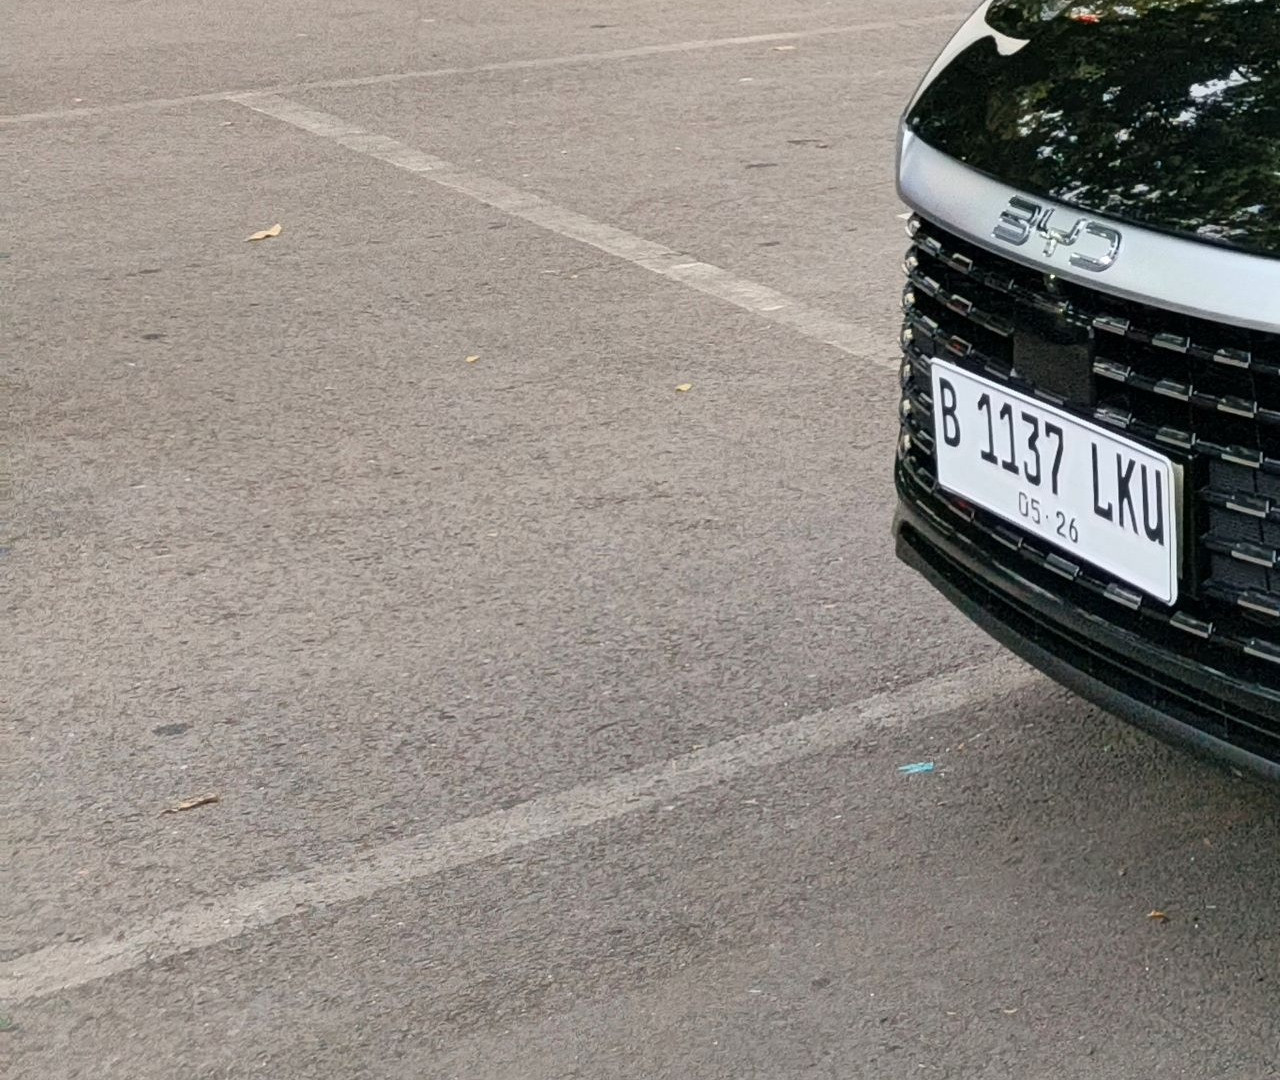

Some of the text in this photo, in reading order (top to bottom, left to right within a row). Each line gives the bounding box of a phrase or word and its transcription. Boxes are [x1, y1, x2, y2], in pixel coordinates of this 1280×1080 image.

[991, 194, 1123, 273] BYD
[939, 376, 1165, 547] B 1137 LKU
